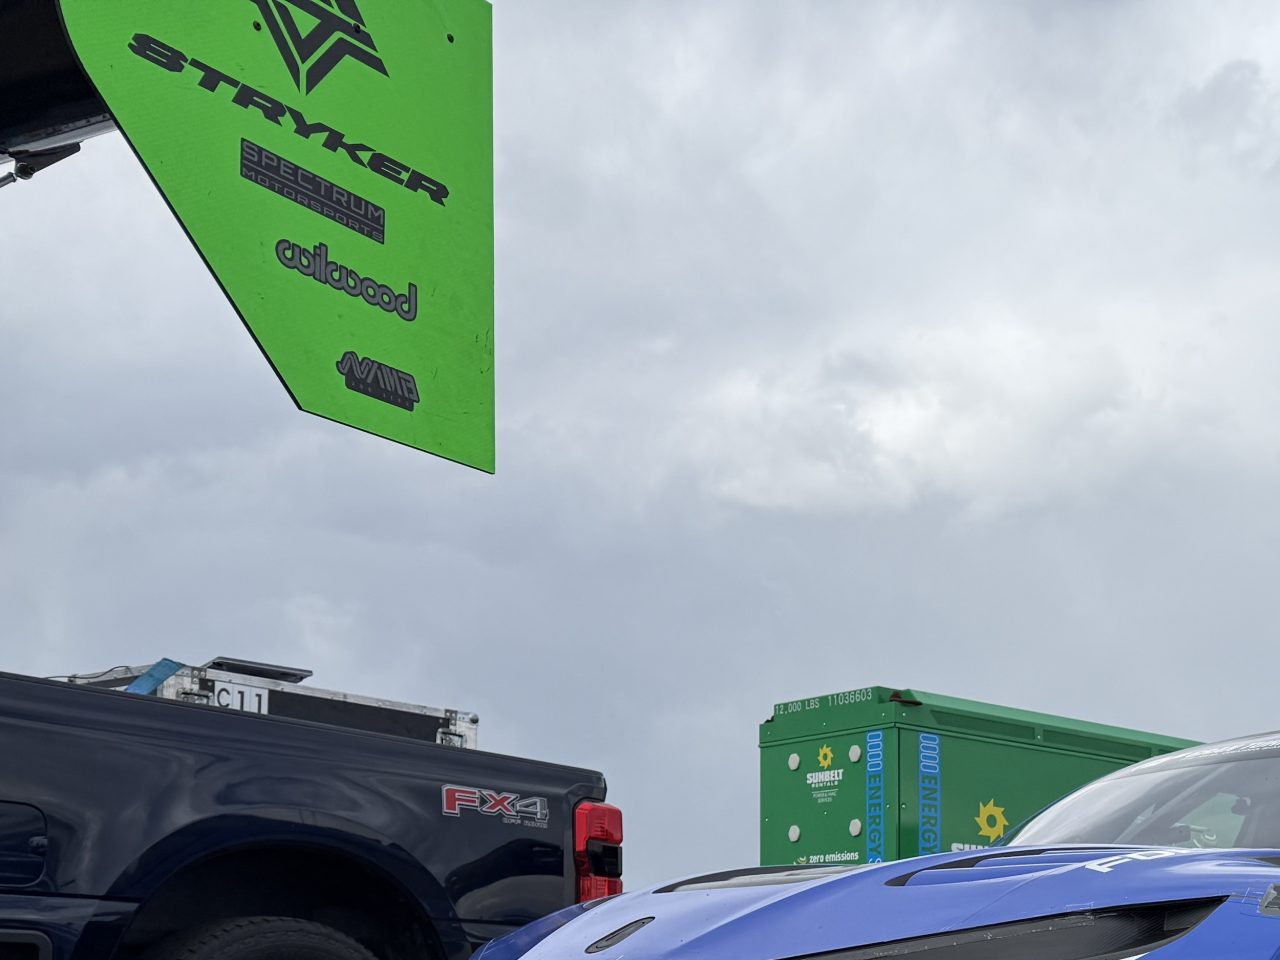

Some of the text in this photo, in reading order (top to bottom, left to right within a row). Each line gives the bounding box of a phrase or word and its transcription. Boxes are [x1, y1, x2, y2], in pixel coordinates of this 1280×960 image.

[128, 33, 449, 206] STRYKER
[242, 140, 384, 225] SPECTRUM
[242, 167, 384, 241] MOTORSPORTS
[275, 239, 417, 321] wilwood
[217, 688, 265, 713] C11
[805, 698, 820, 710] LBS
[828, 688, 872, 706] 11036603
[442, 784, 549, 822] FX4
[806, 769, 844, 784] SUNBELT
[868, 775, 882, 855] ENERGY
[809, 854, 824, 864] zero
[825, 851, 859, 862] emissions
